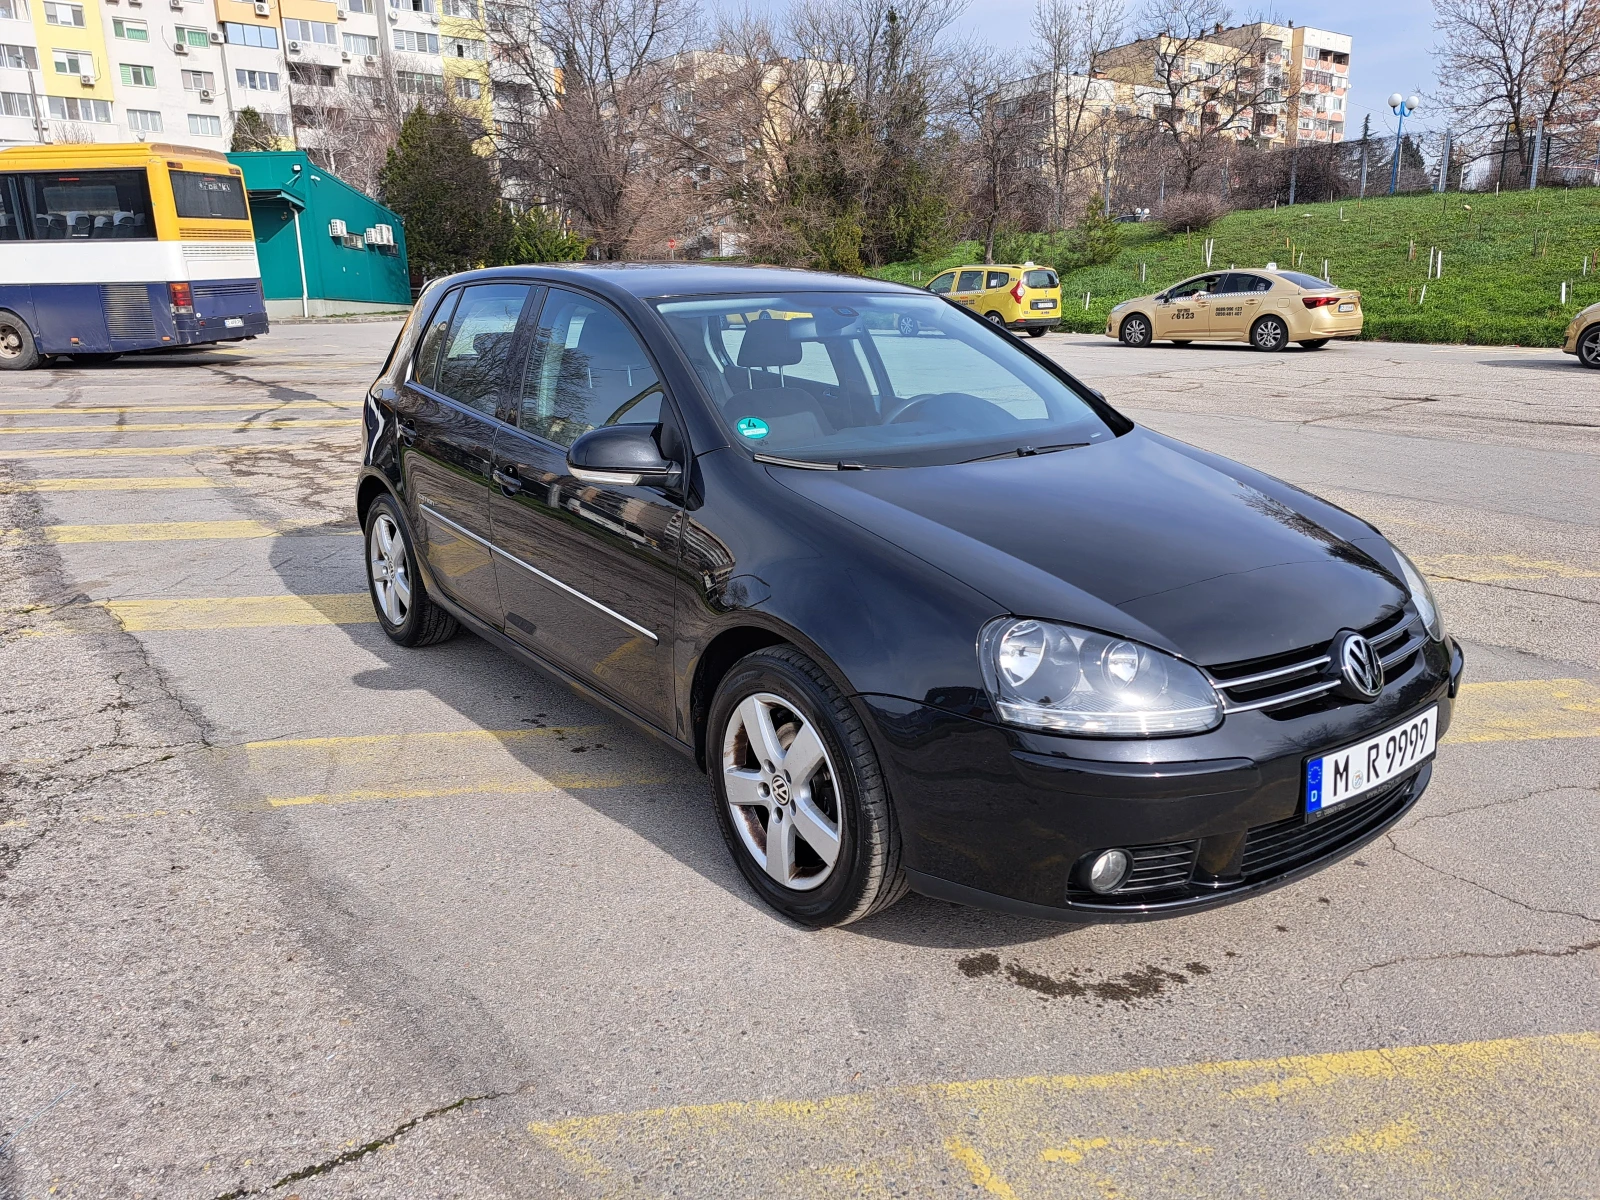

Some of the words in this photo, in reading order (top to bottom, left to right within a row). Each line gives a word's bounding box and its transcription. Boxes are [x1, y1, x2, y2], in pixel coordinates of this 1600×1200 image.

[1176, 312, 1195, 320] 6123
[747, 419, 757, 428] 4
[1333, 754, 1350, 797] M
[1385, 717, 1429, 774] 9999
[1310, 790, 1318, 802] D
